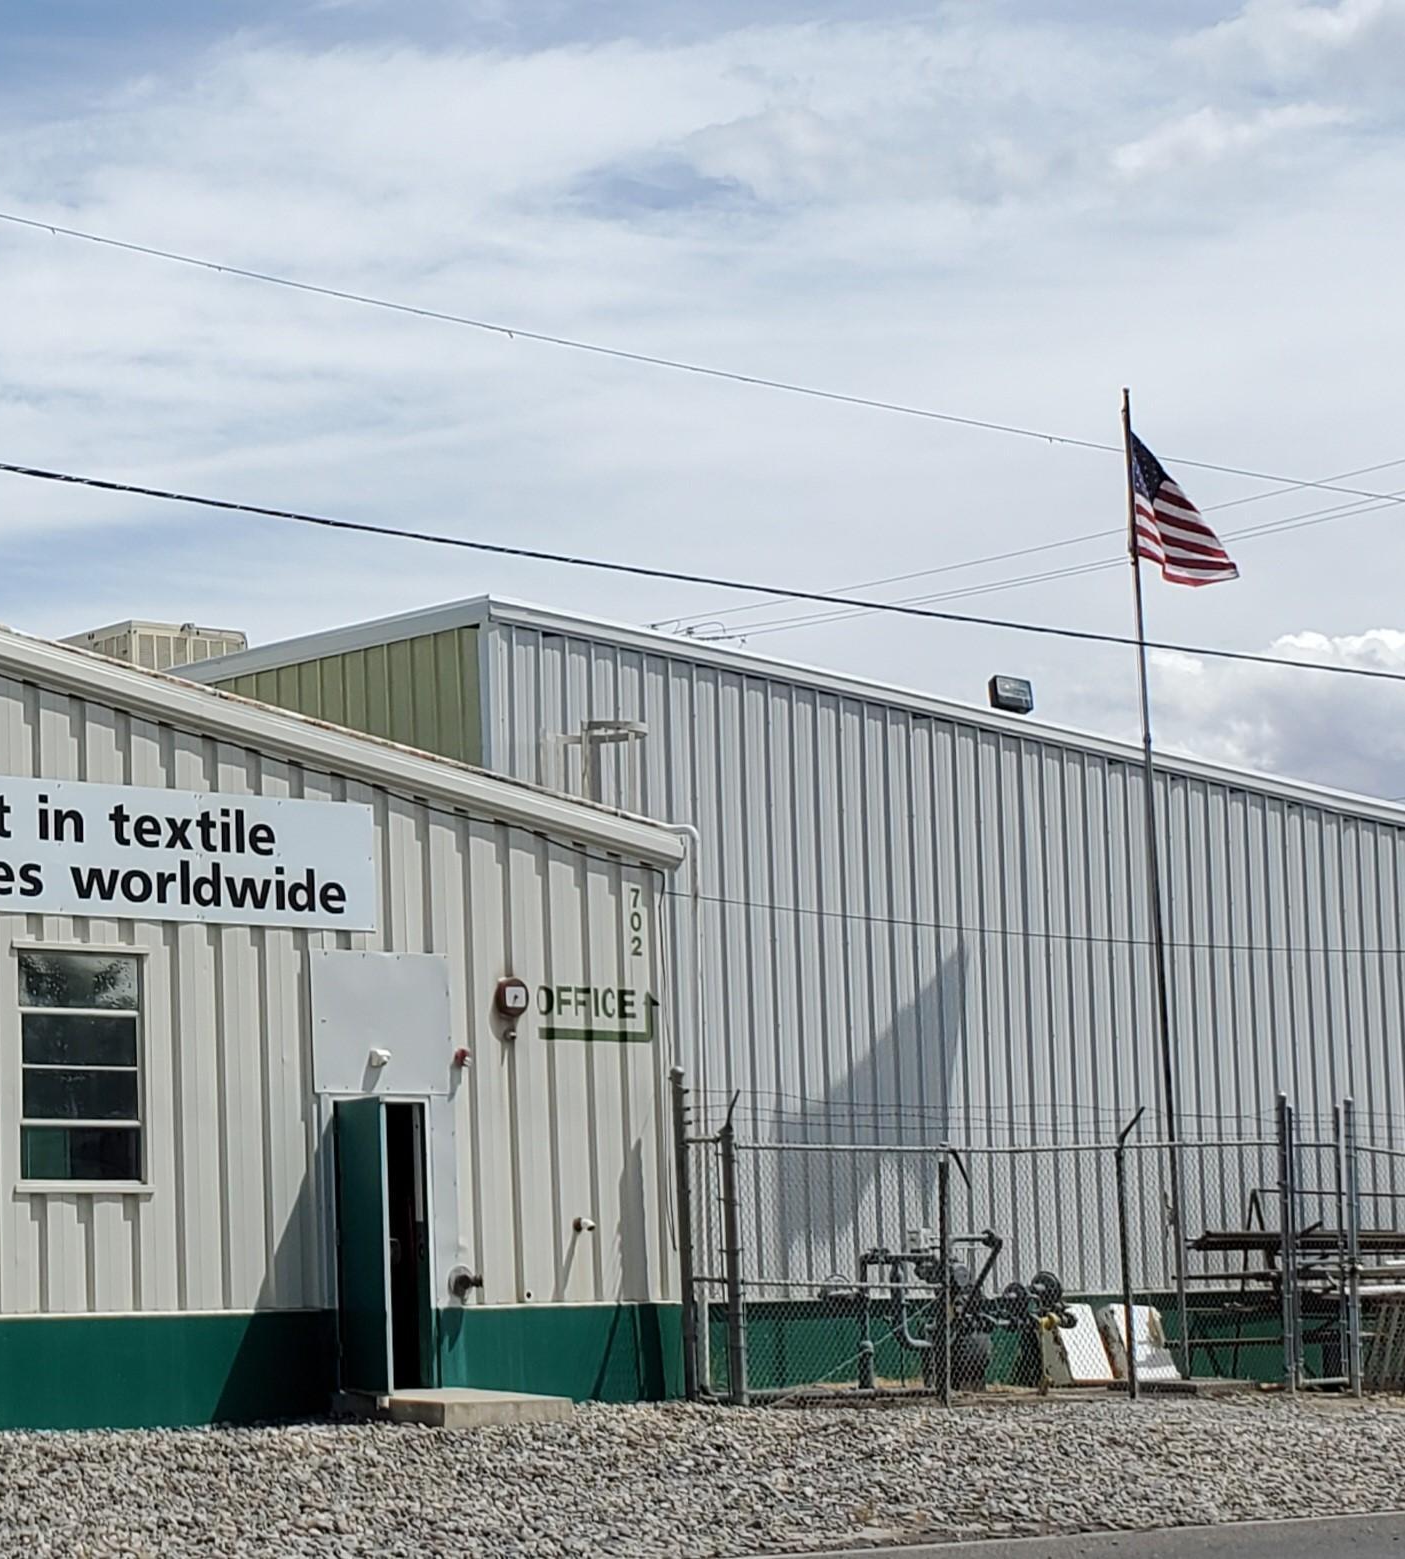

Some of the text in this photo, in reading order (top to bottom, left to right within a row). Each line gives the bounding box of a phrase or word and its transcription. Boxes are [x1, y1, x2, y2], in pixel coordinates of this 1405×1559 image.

[37, 794, 84, 843] in
[109, 803, 276, 856] textile
[70, 860, 347, 914] worldwide
[630, 887, 643, 957] 702
[536, 985, 637, 1019] OFFICE
